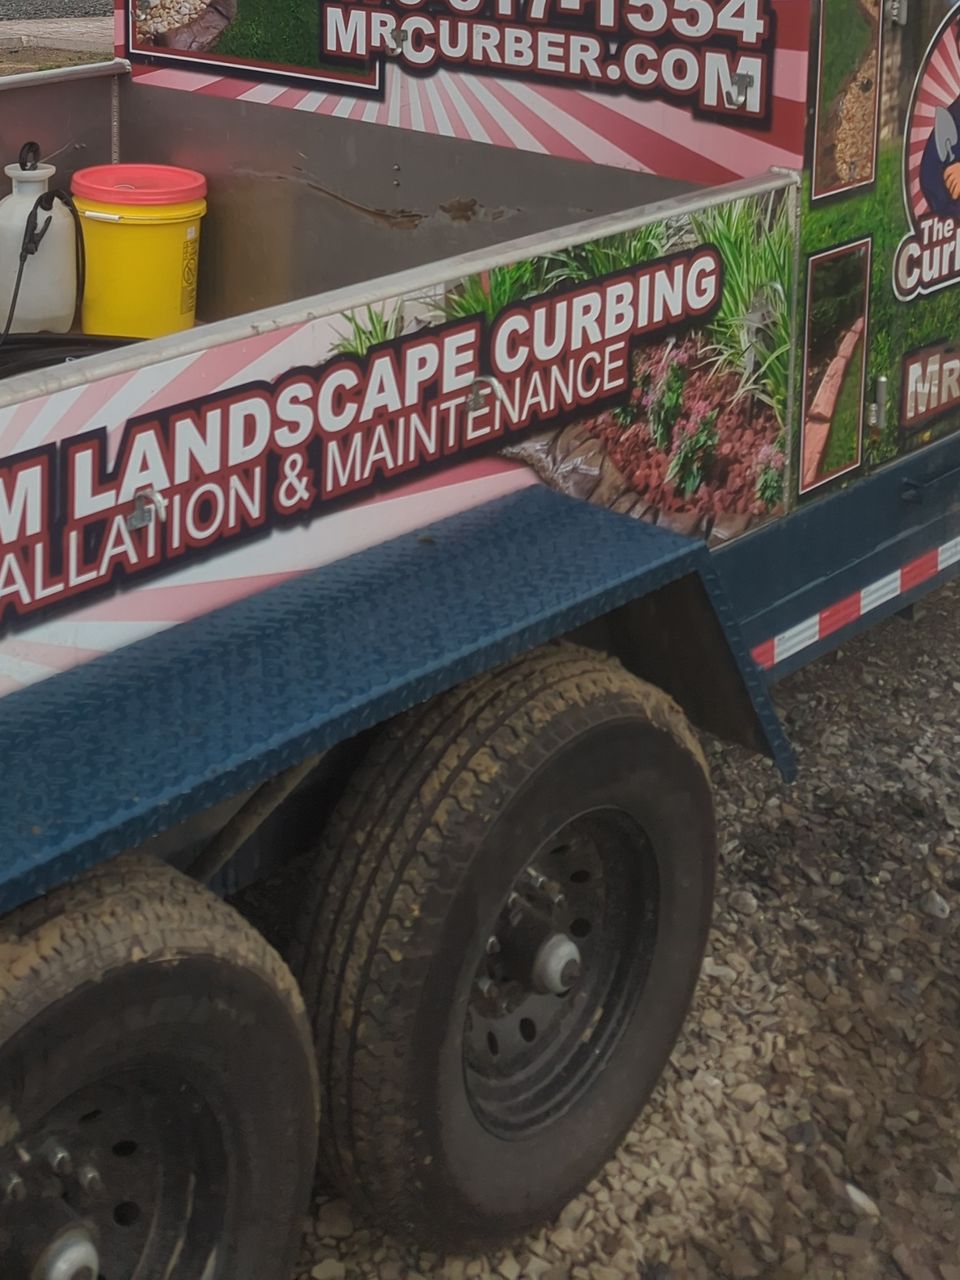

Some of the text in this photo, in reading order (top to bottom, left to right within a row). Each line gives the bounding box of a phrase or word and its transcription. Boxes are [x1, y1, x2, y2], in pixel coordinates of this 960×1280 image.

[920, 216, 955, 245] The
[73, 328, 477, 520] LANDSCAPE
[493, 255, 717, 374] CURBING
[278, 453, 311, 508] &
[325, 341, 626, 493] MAINTENANCE
